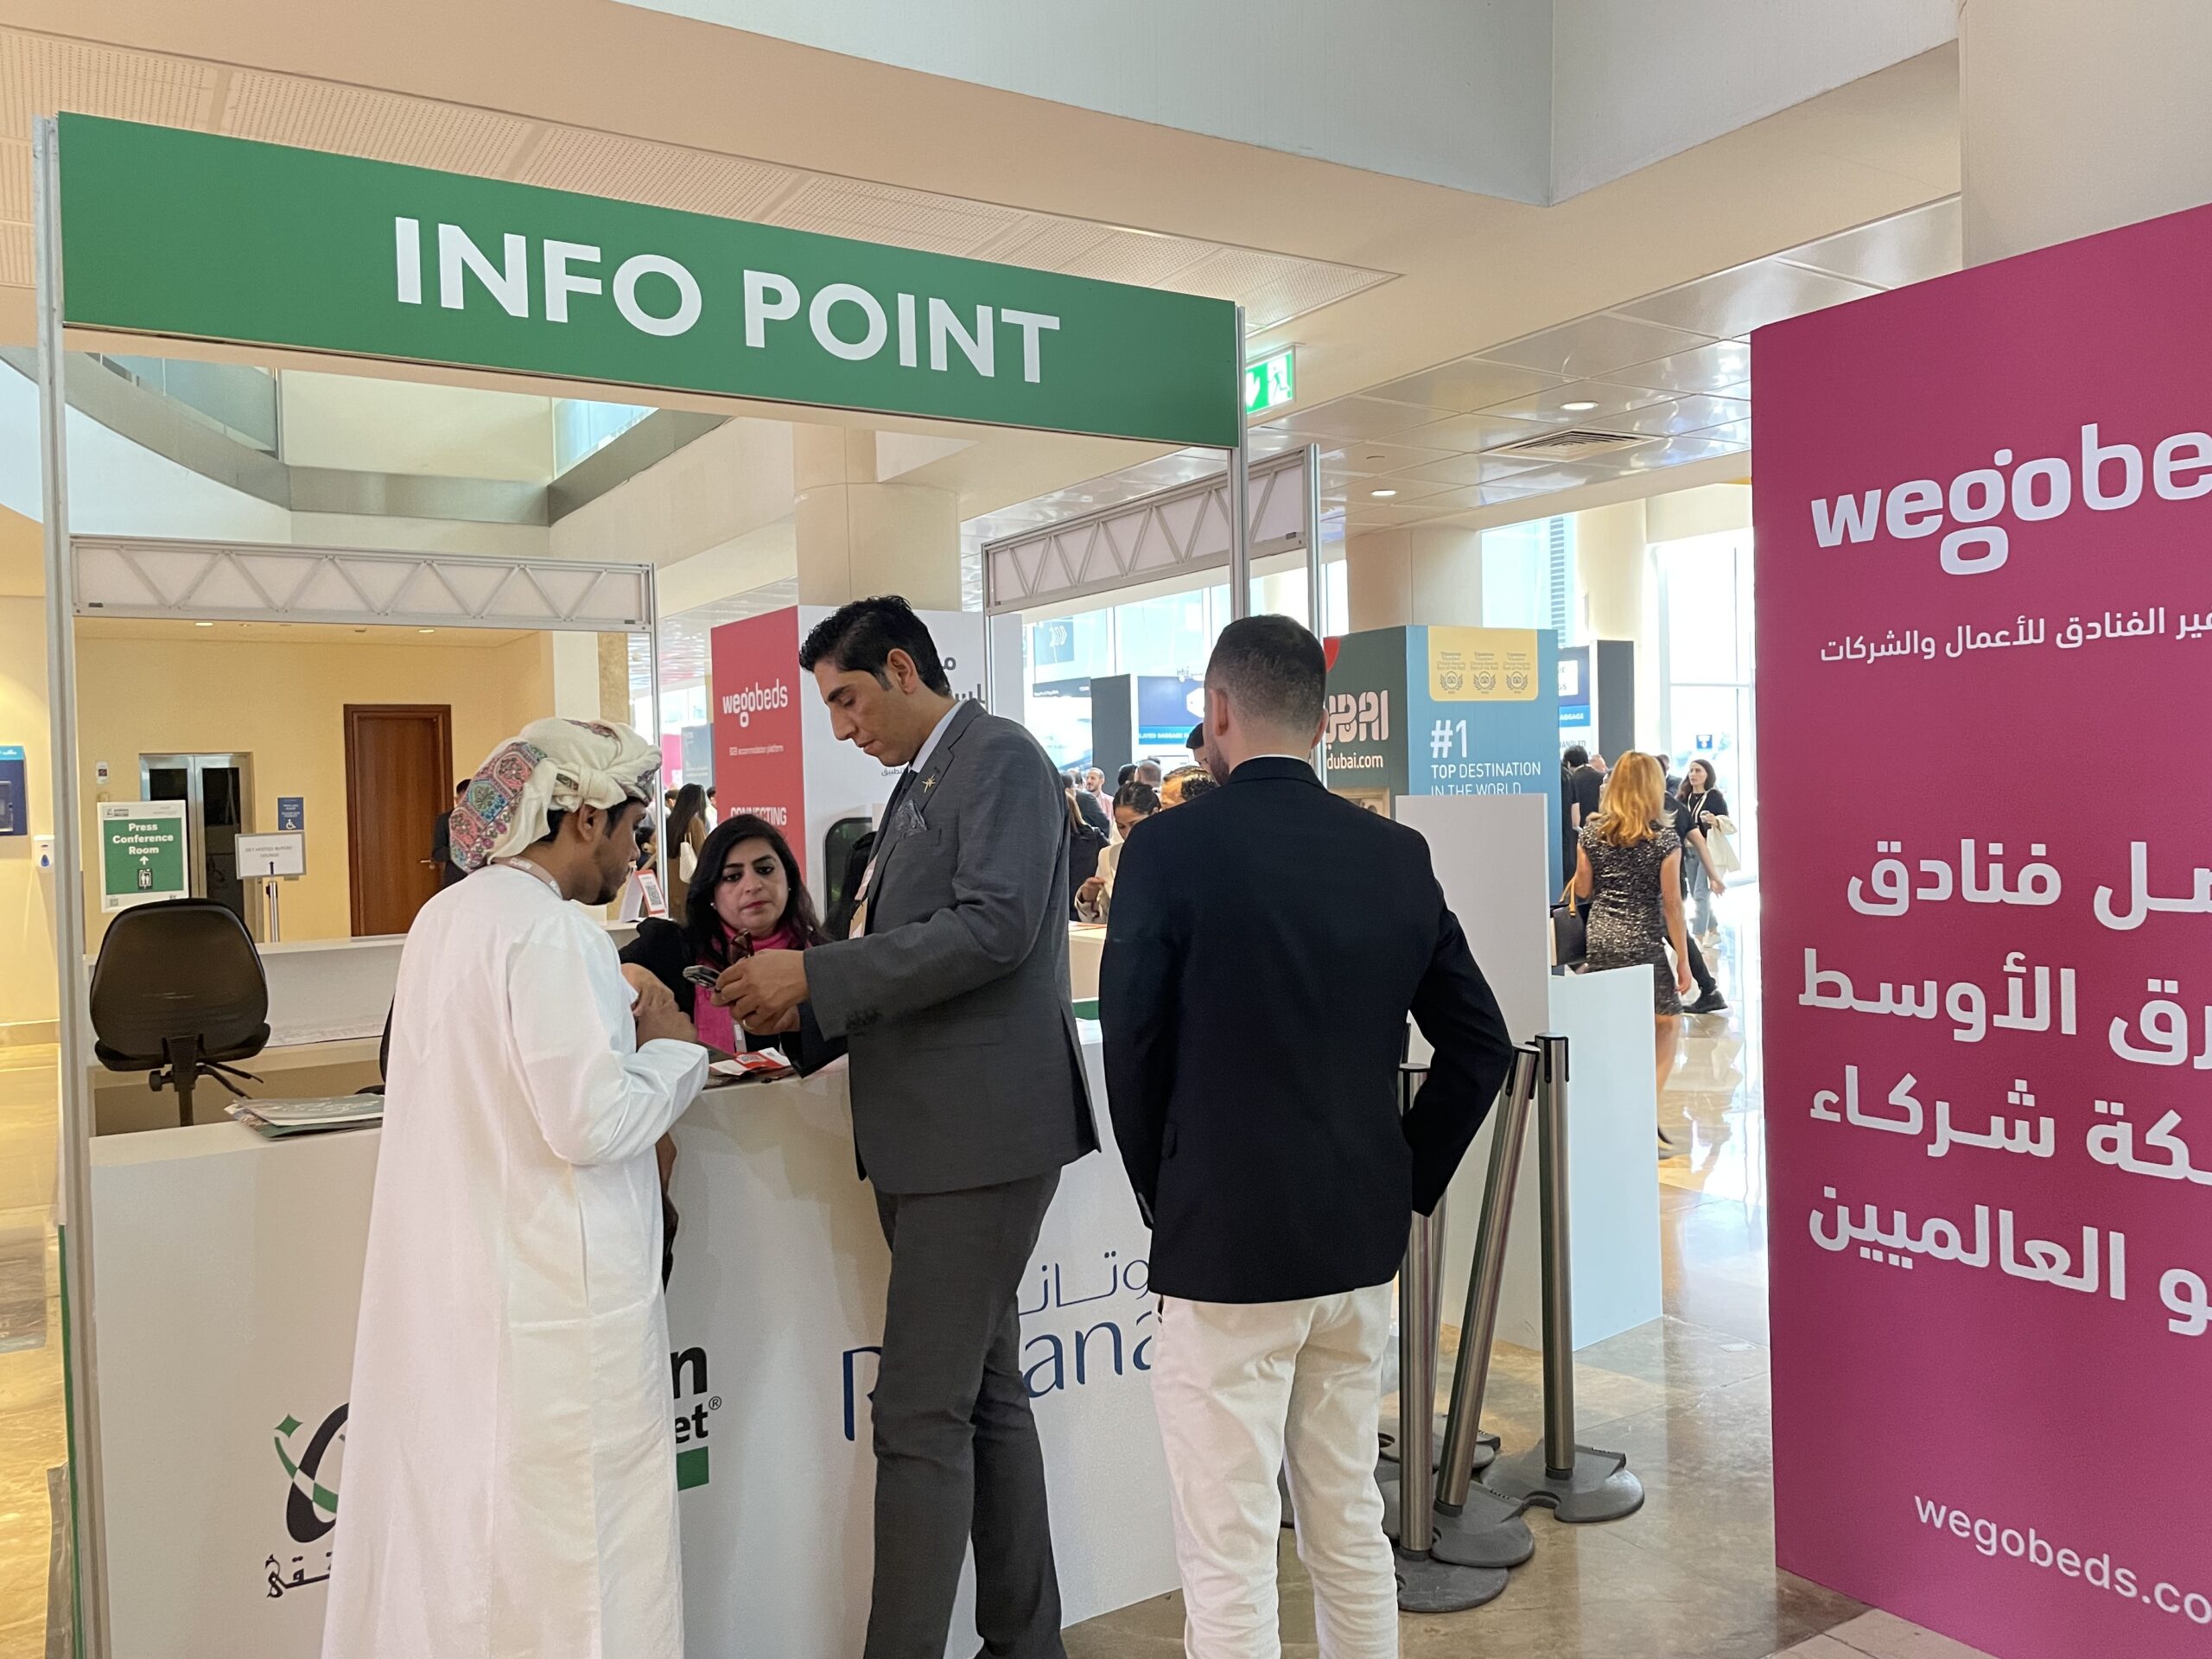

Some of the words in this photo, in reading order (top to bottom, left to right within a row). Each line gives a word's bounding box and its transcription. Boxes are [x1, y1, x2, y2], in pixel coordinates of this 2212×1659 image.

[396, 216, 702, 336] INFO
[744, 270, 1060, 383] POINT
[1821, 630, 1936, 664] والشركات
[1945, 614, 2045, 658] للأعمال
[2056, 607, 2165, 649] الفنادق
[722, 678, 788, 728] wegobeds
[1430, 719, 1467, 759] #1
[1431, 764, 1457, 779] TOP
[1459, 761, 1541, 779] DESTINATION
[1431, 785, 1446, 796] IN
[1450, 783, 1473, 796] THE
[1476, 782, 1522, 796] WORLD
[112, 834, 175, 844] Conference
[129, 823, 158, 832] Press
[129, 846, 160, 855] Room
[1847, 838, 2062, 917] فنادق
[1798, 948, 2076, 1043] الأوسط
[1810, 1065, 2055, 1158] شركاء
[1809, 1185, 2126, 1301] العالميين
[1915, 1496, 2212, 1624] wegobeds.co
